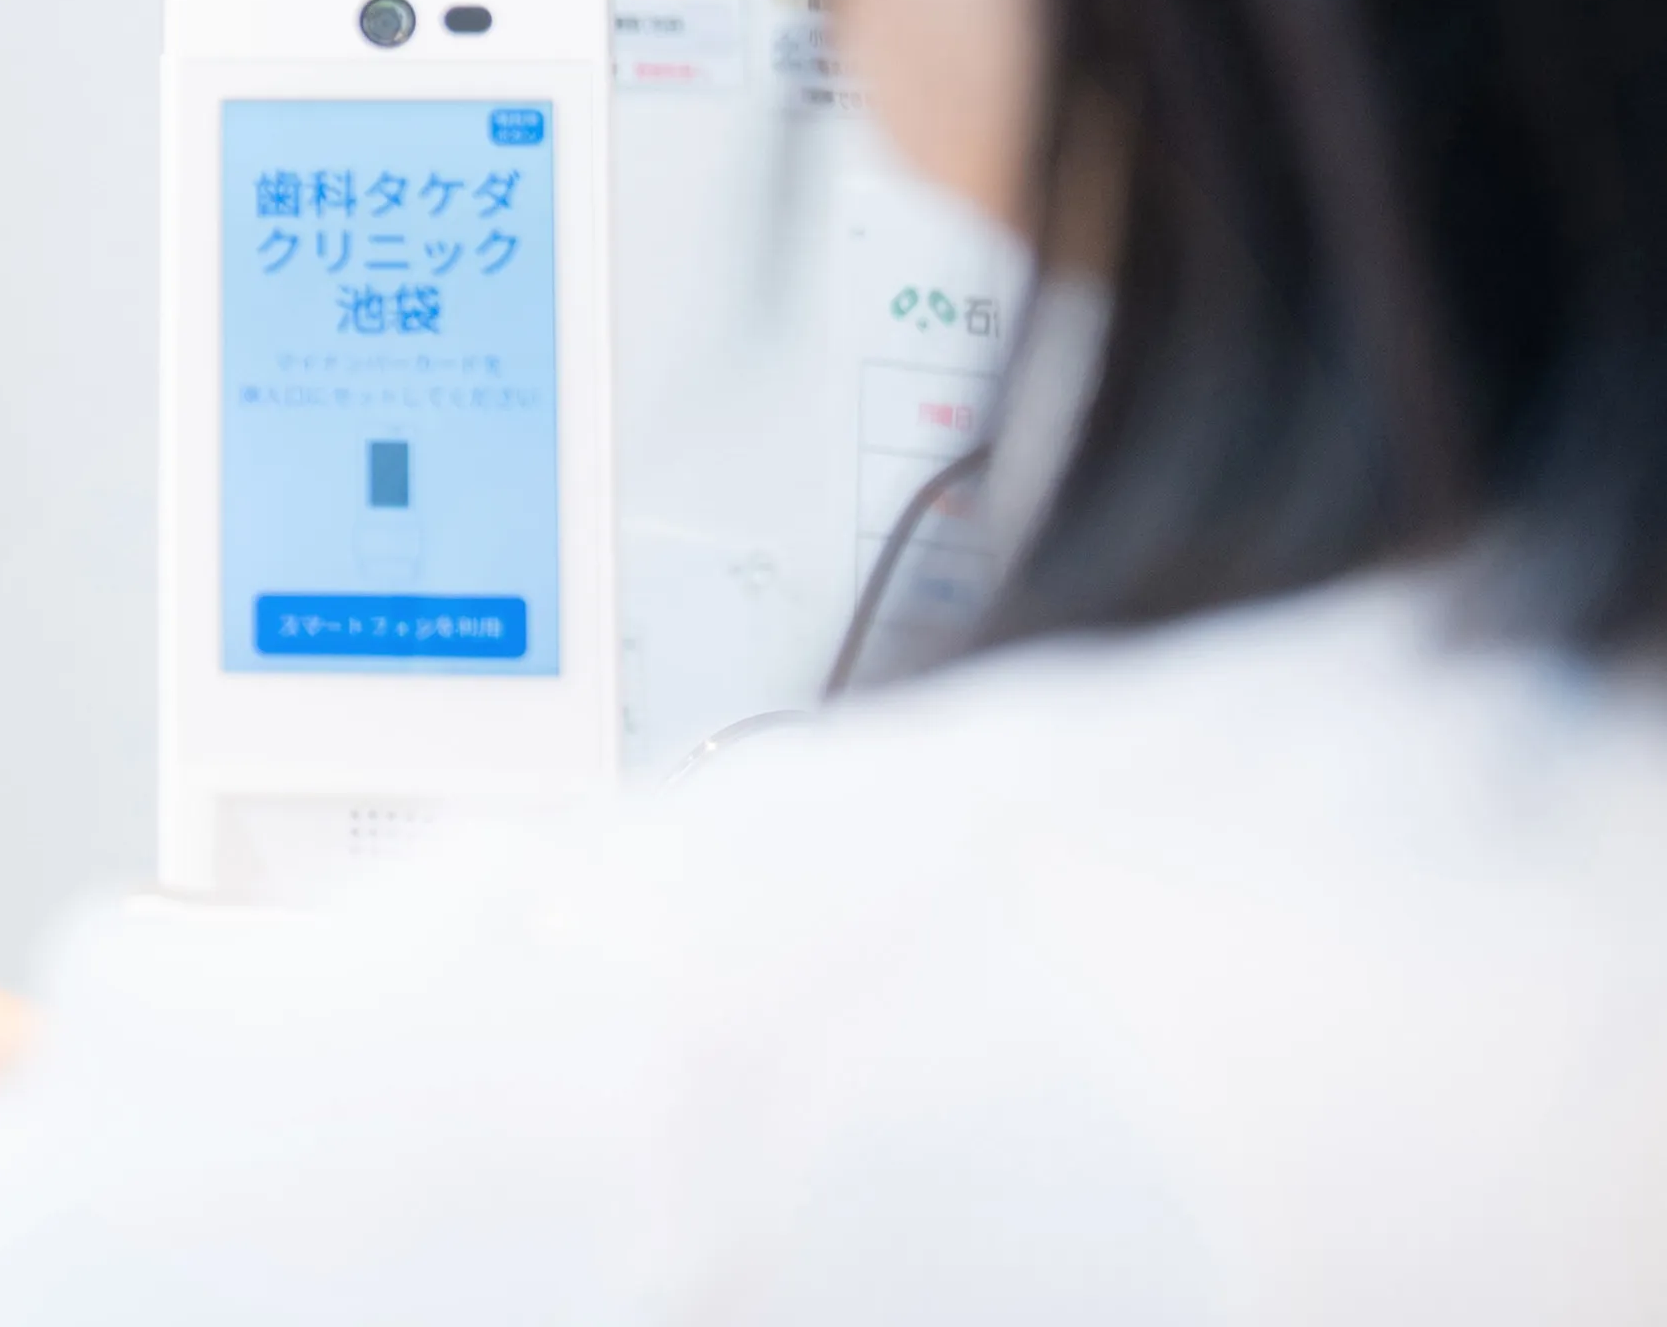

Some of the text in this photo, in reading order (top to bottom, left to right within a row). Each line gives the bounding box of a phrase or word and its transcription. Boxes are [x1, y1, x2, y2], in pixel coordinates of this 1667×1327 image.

[255, 169, 521, 218] 歯科タケダ
[256, 228, 519, 276] クリニック
[335, 285, 443, 335] 池袋
